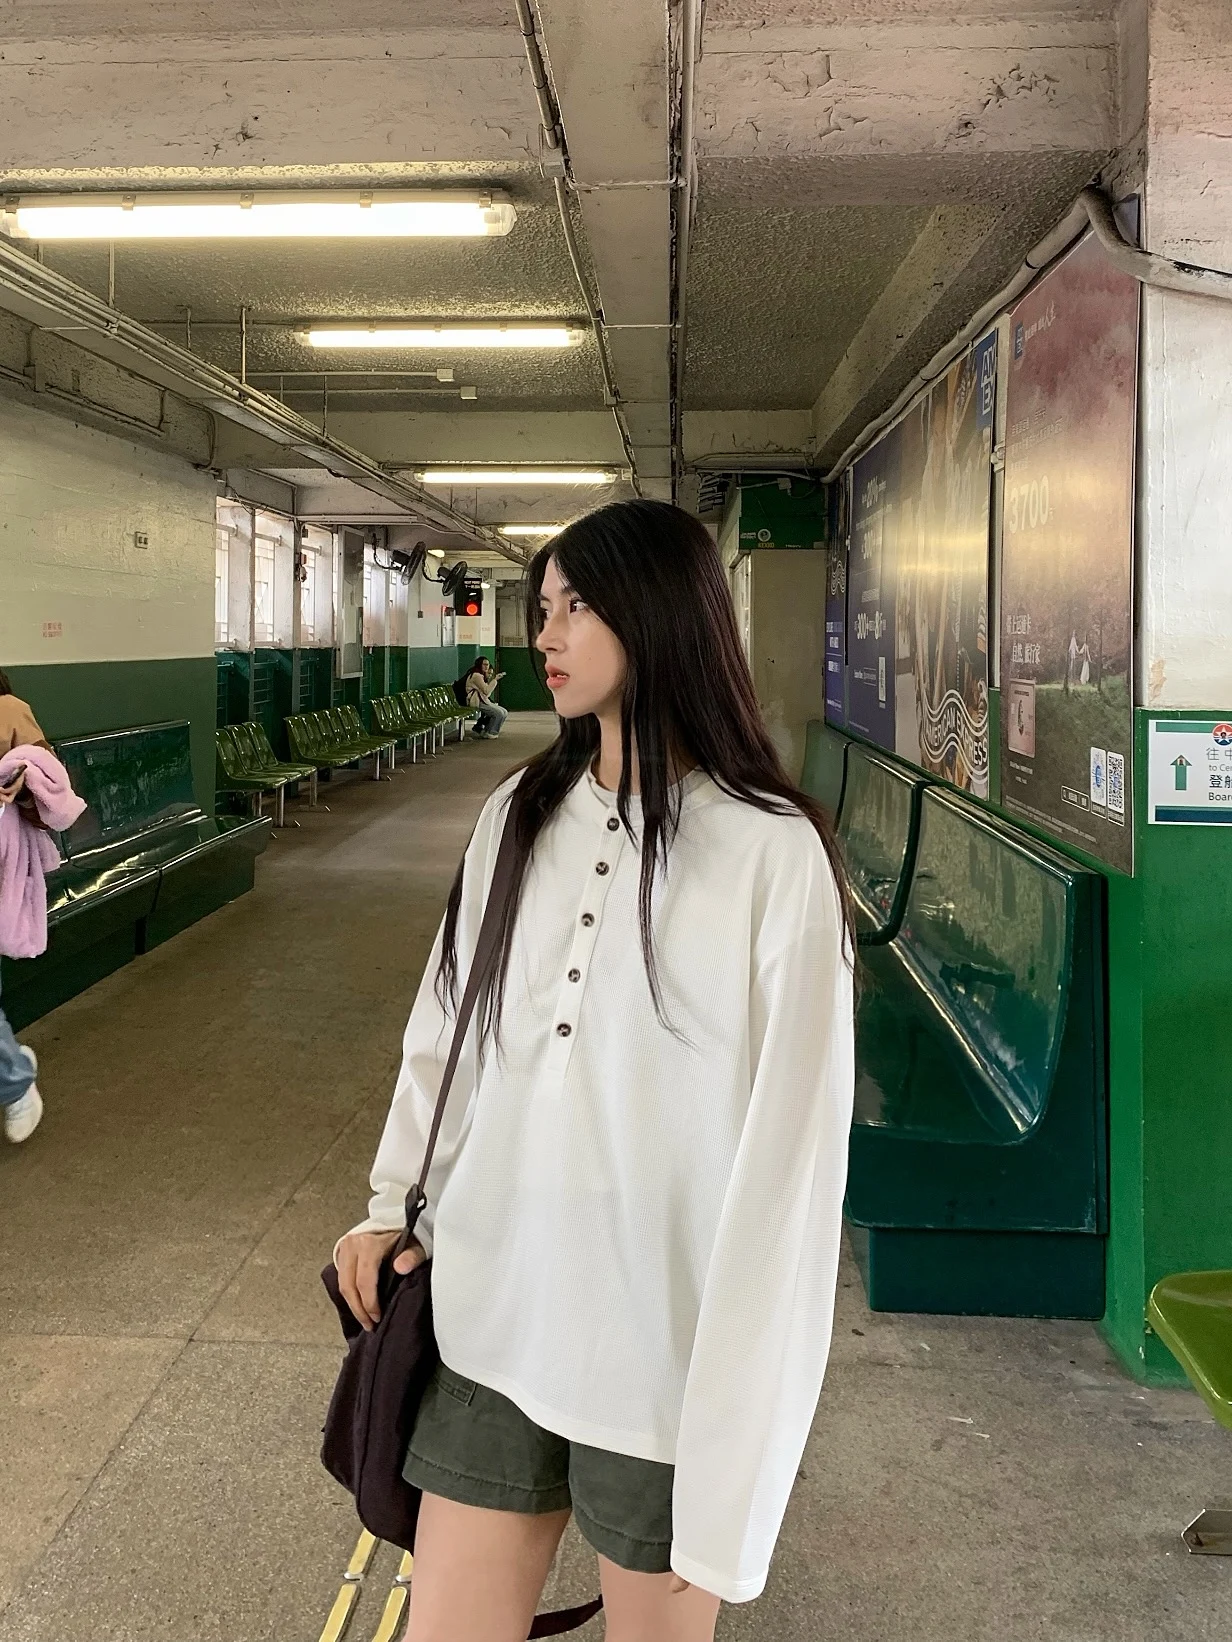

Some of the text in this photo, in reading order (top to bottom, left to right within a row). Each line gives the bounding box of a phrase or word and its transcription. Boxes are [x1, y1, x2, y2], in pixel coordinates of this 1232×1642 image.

[1009, 475, 1049, 534] 3700
[956, 709, 988, 766] EXPRESS
[1208, 763, 1232, 772] to Ce
[1208, 792, 1232, 801] Boar
